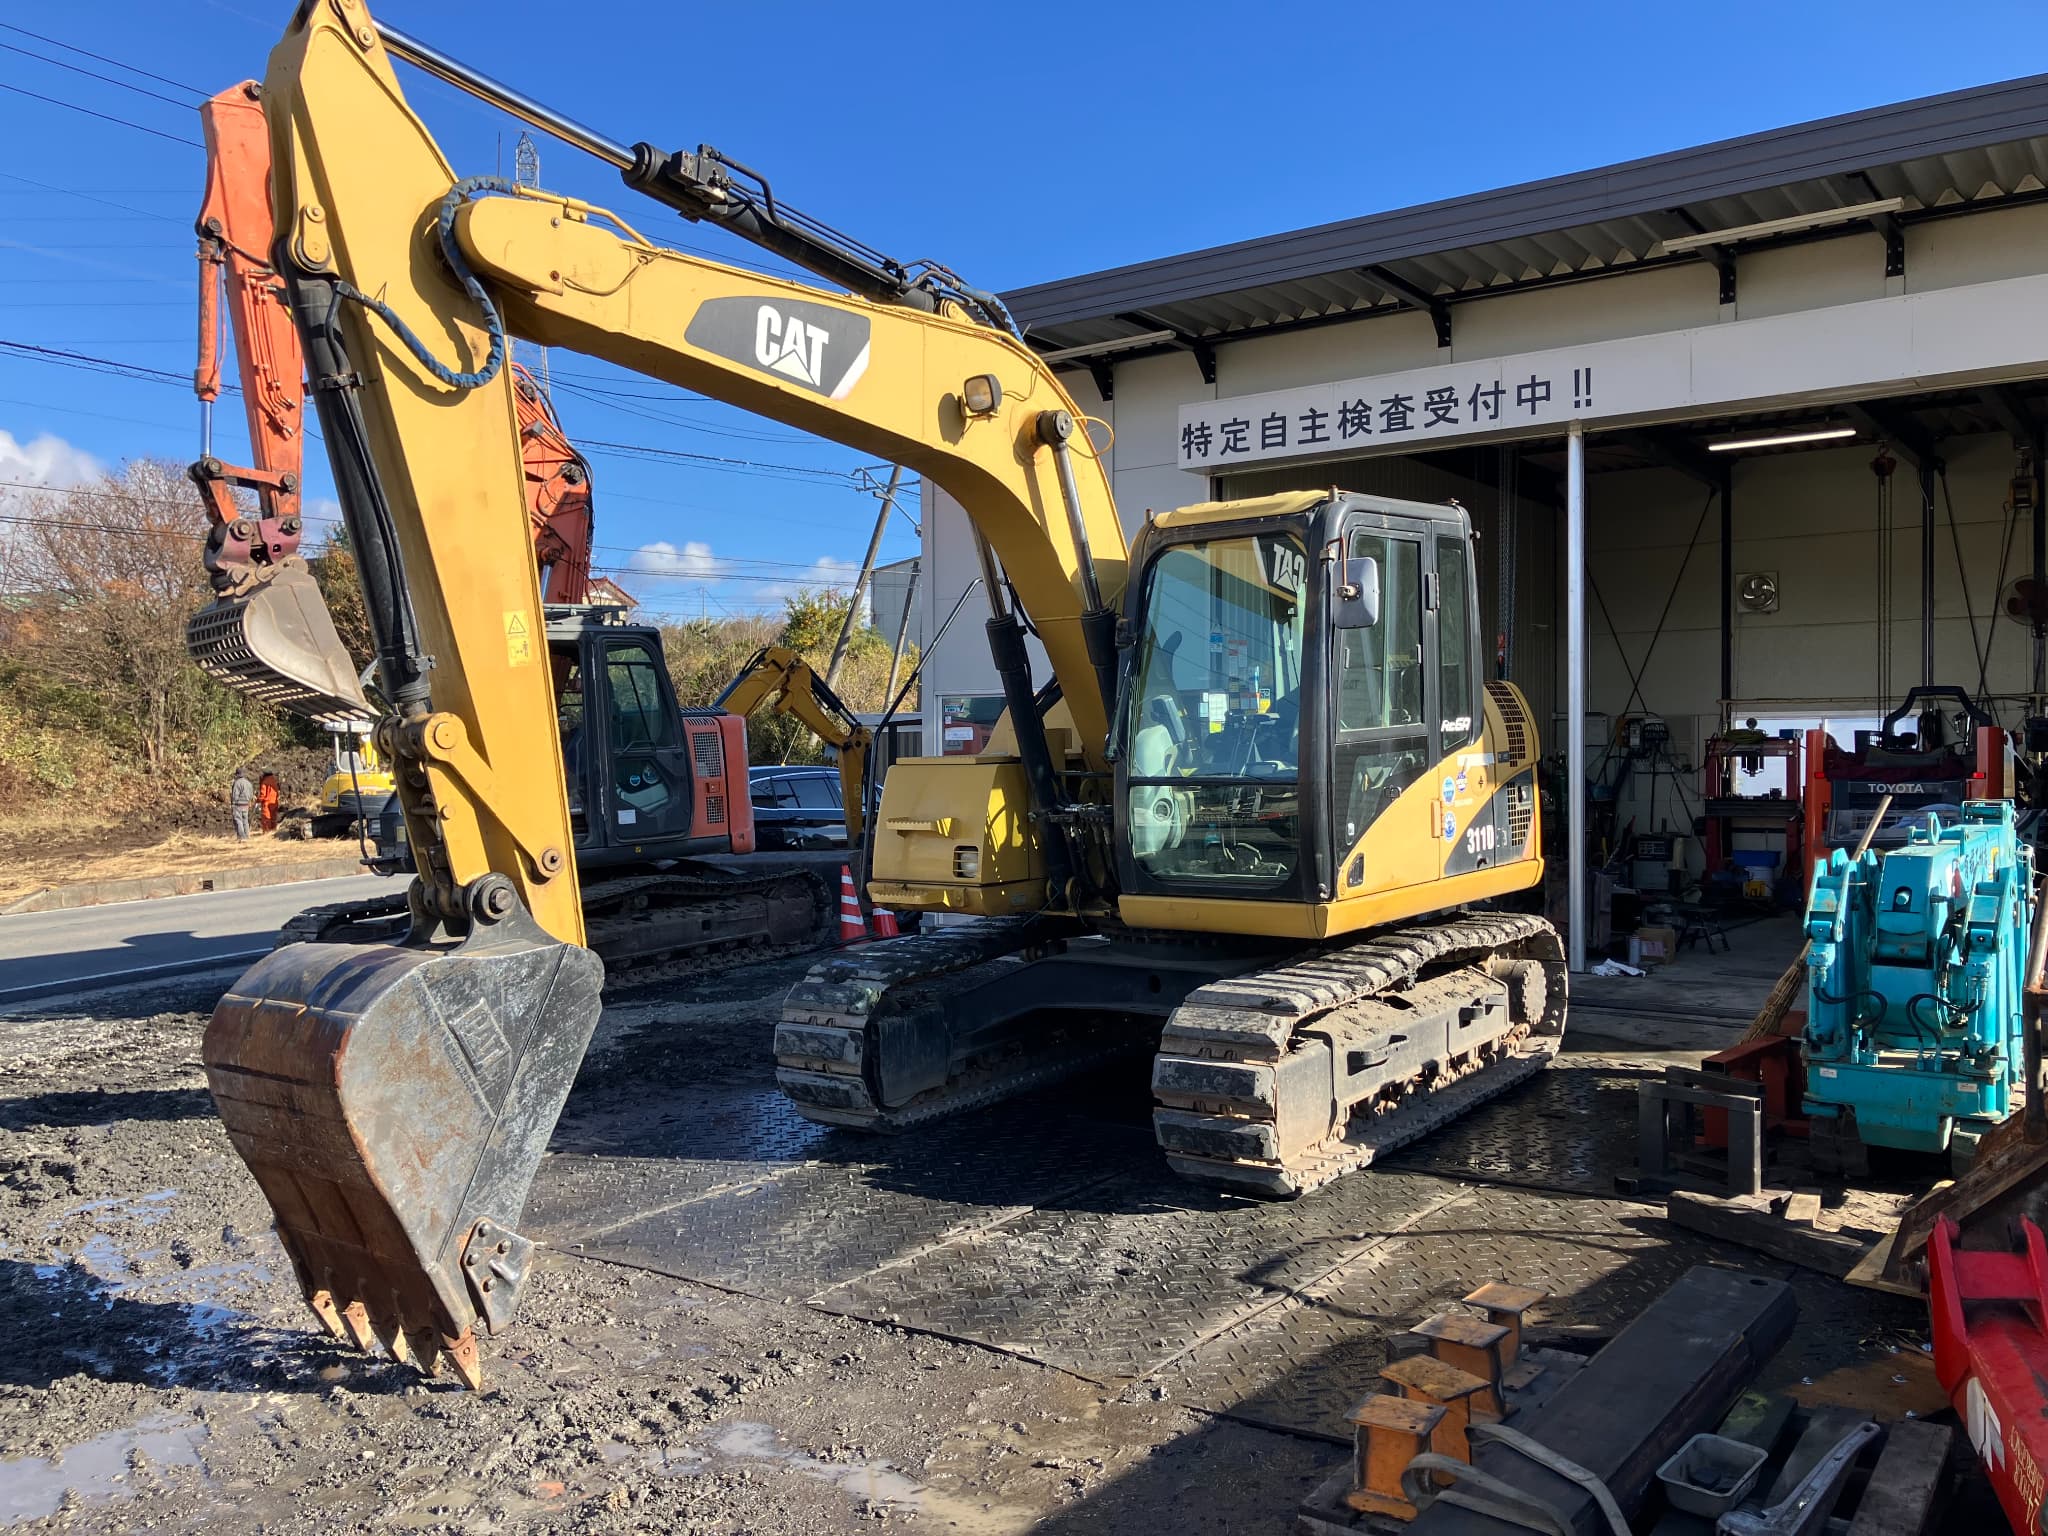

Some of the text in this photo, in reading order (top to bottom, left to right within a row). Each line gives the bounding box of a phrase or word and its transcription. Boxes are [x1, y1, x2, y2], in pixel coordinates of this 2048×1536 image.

[755, 305, 829, 387] CAT
[1868, 783, 1925, 794] TOYOTA
[1466, 824, 1495, 854] 311D
